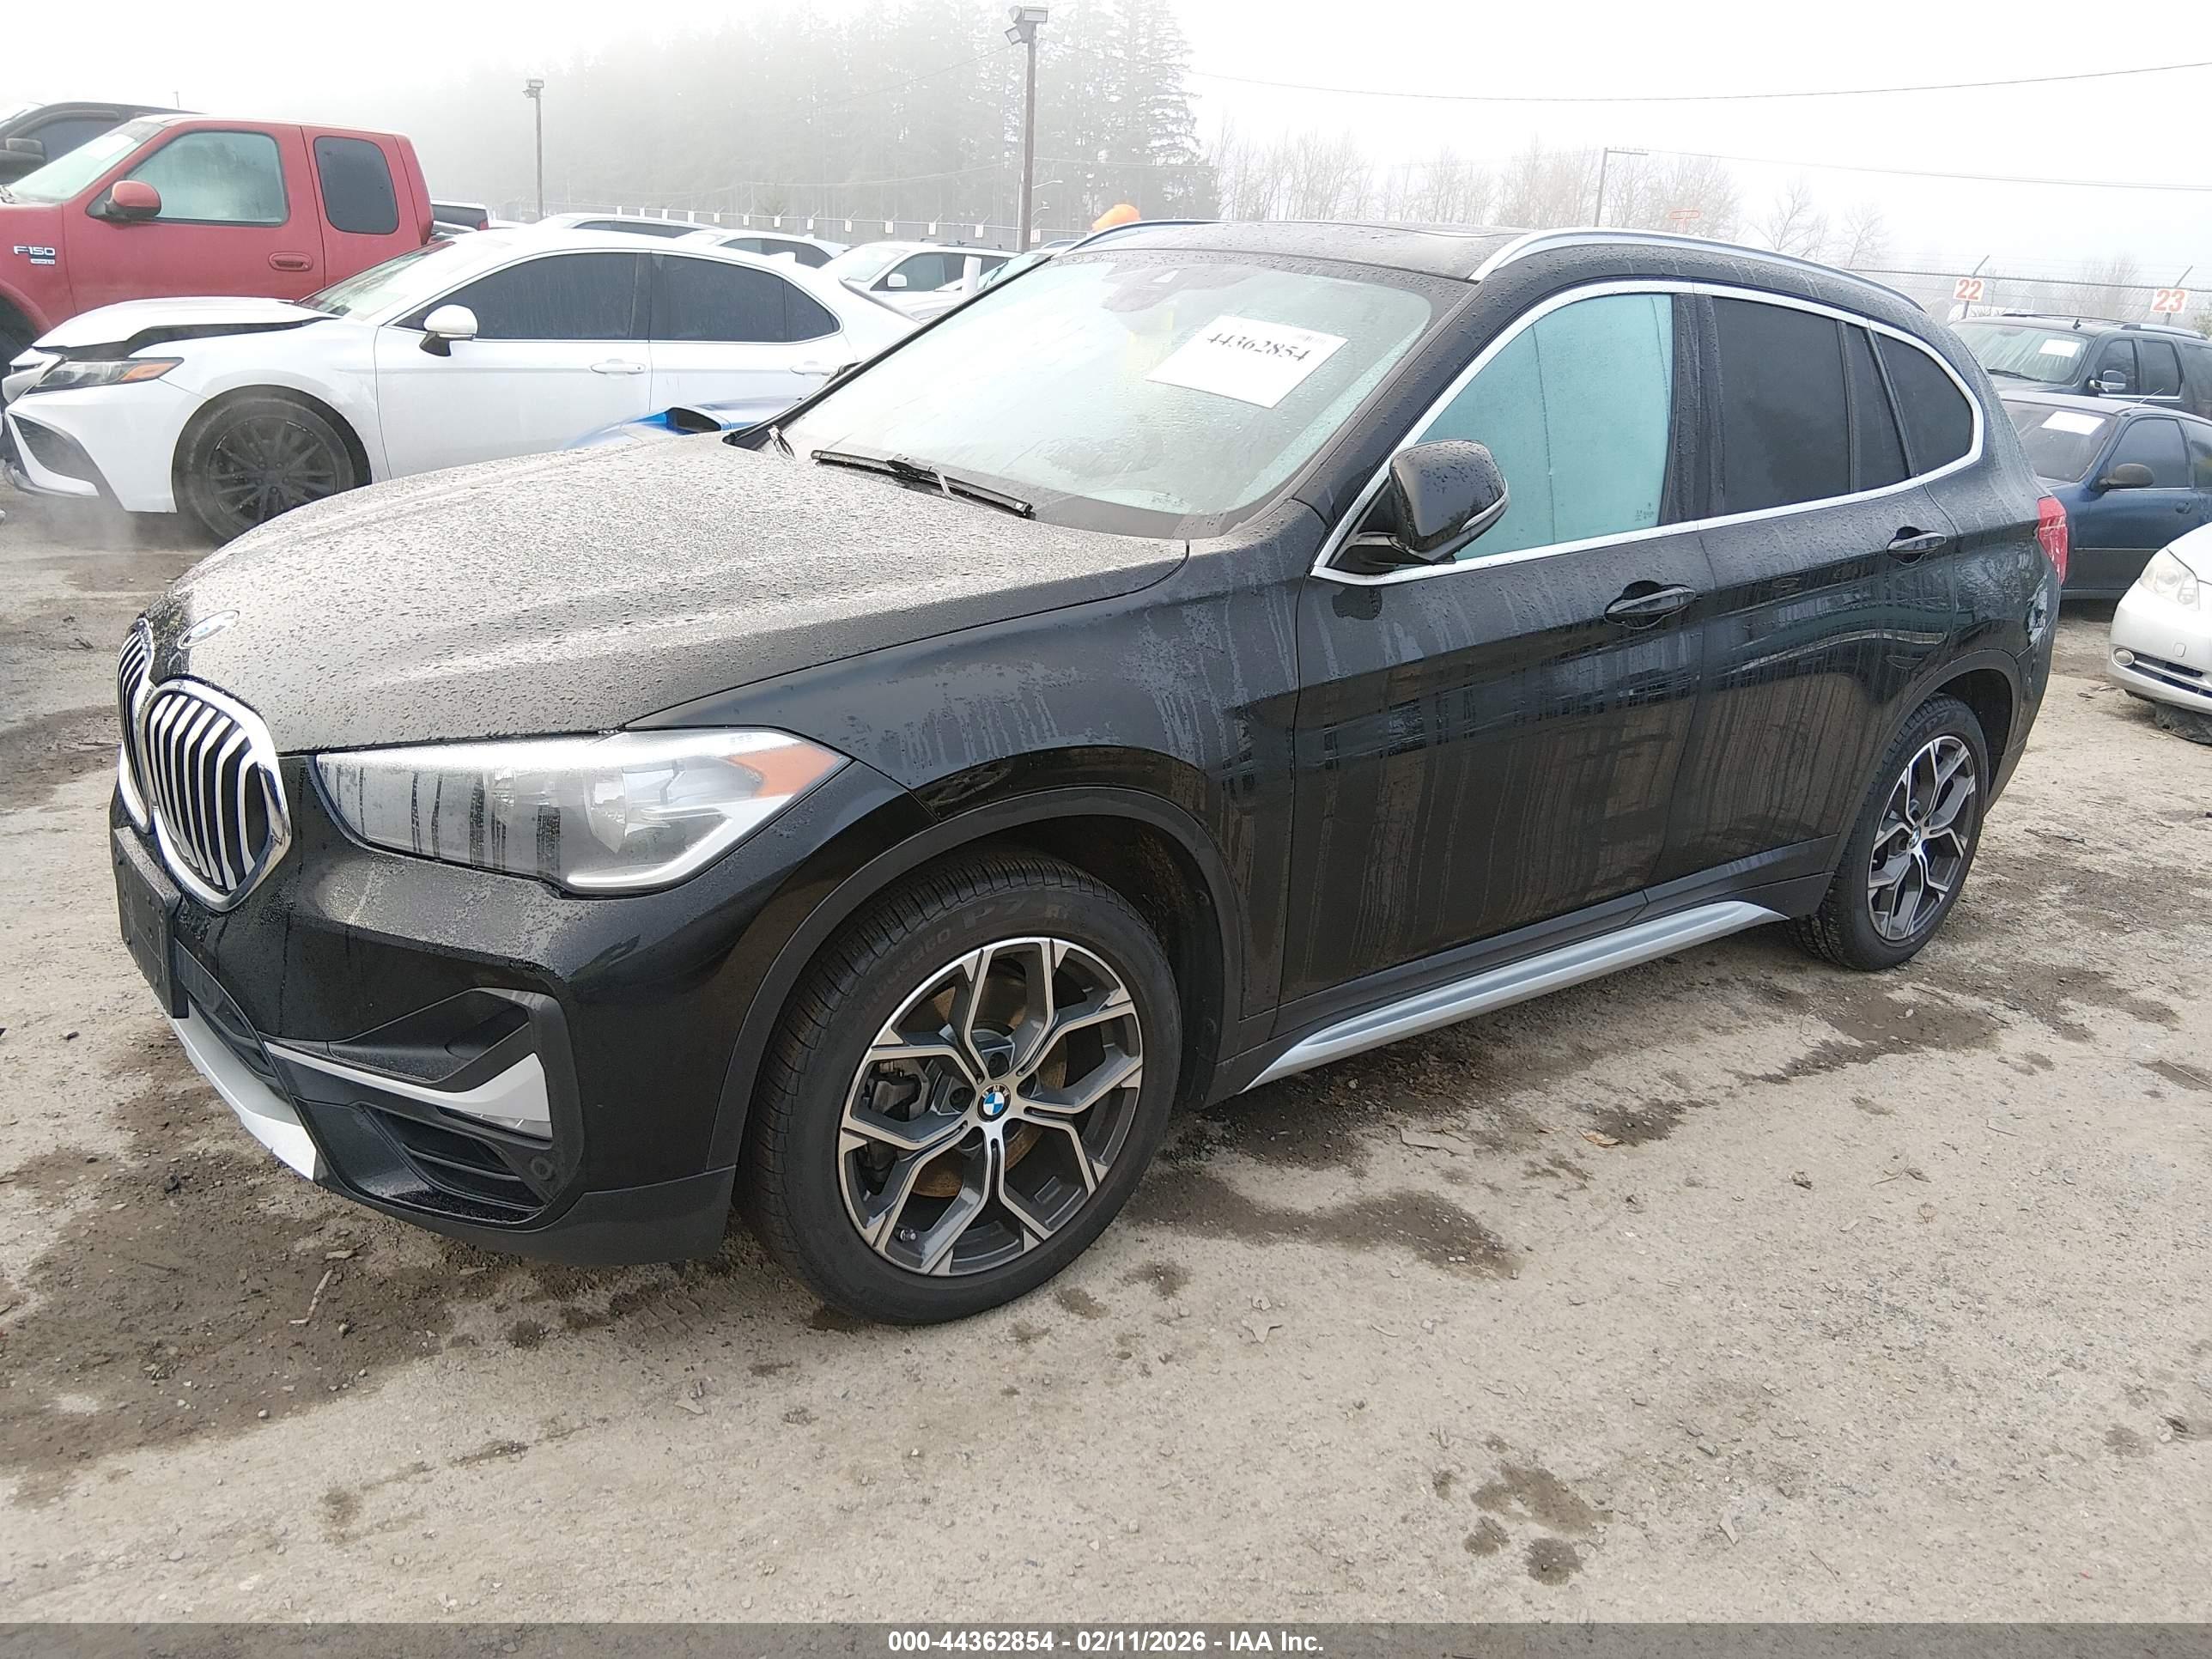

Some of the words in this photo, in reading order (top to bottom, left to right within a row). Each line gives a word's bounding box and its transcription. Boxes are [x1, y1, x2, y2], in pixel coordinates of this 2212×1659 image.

[1955, 279, 1982, 301] 22
[2153, 289, 2185, 313] 23
[1206, 332, 1311, 362] 44362854
